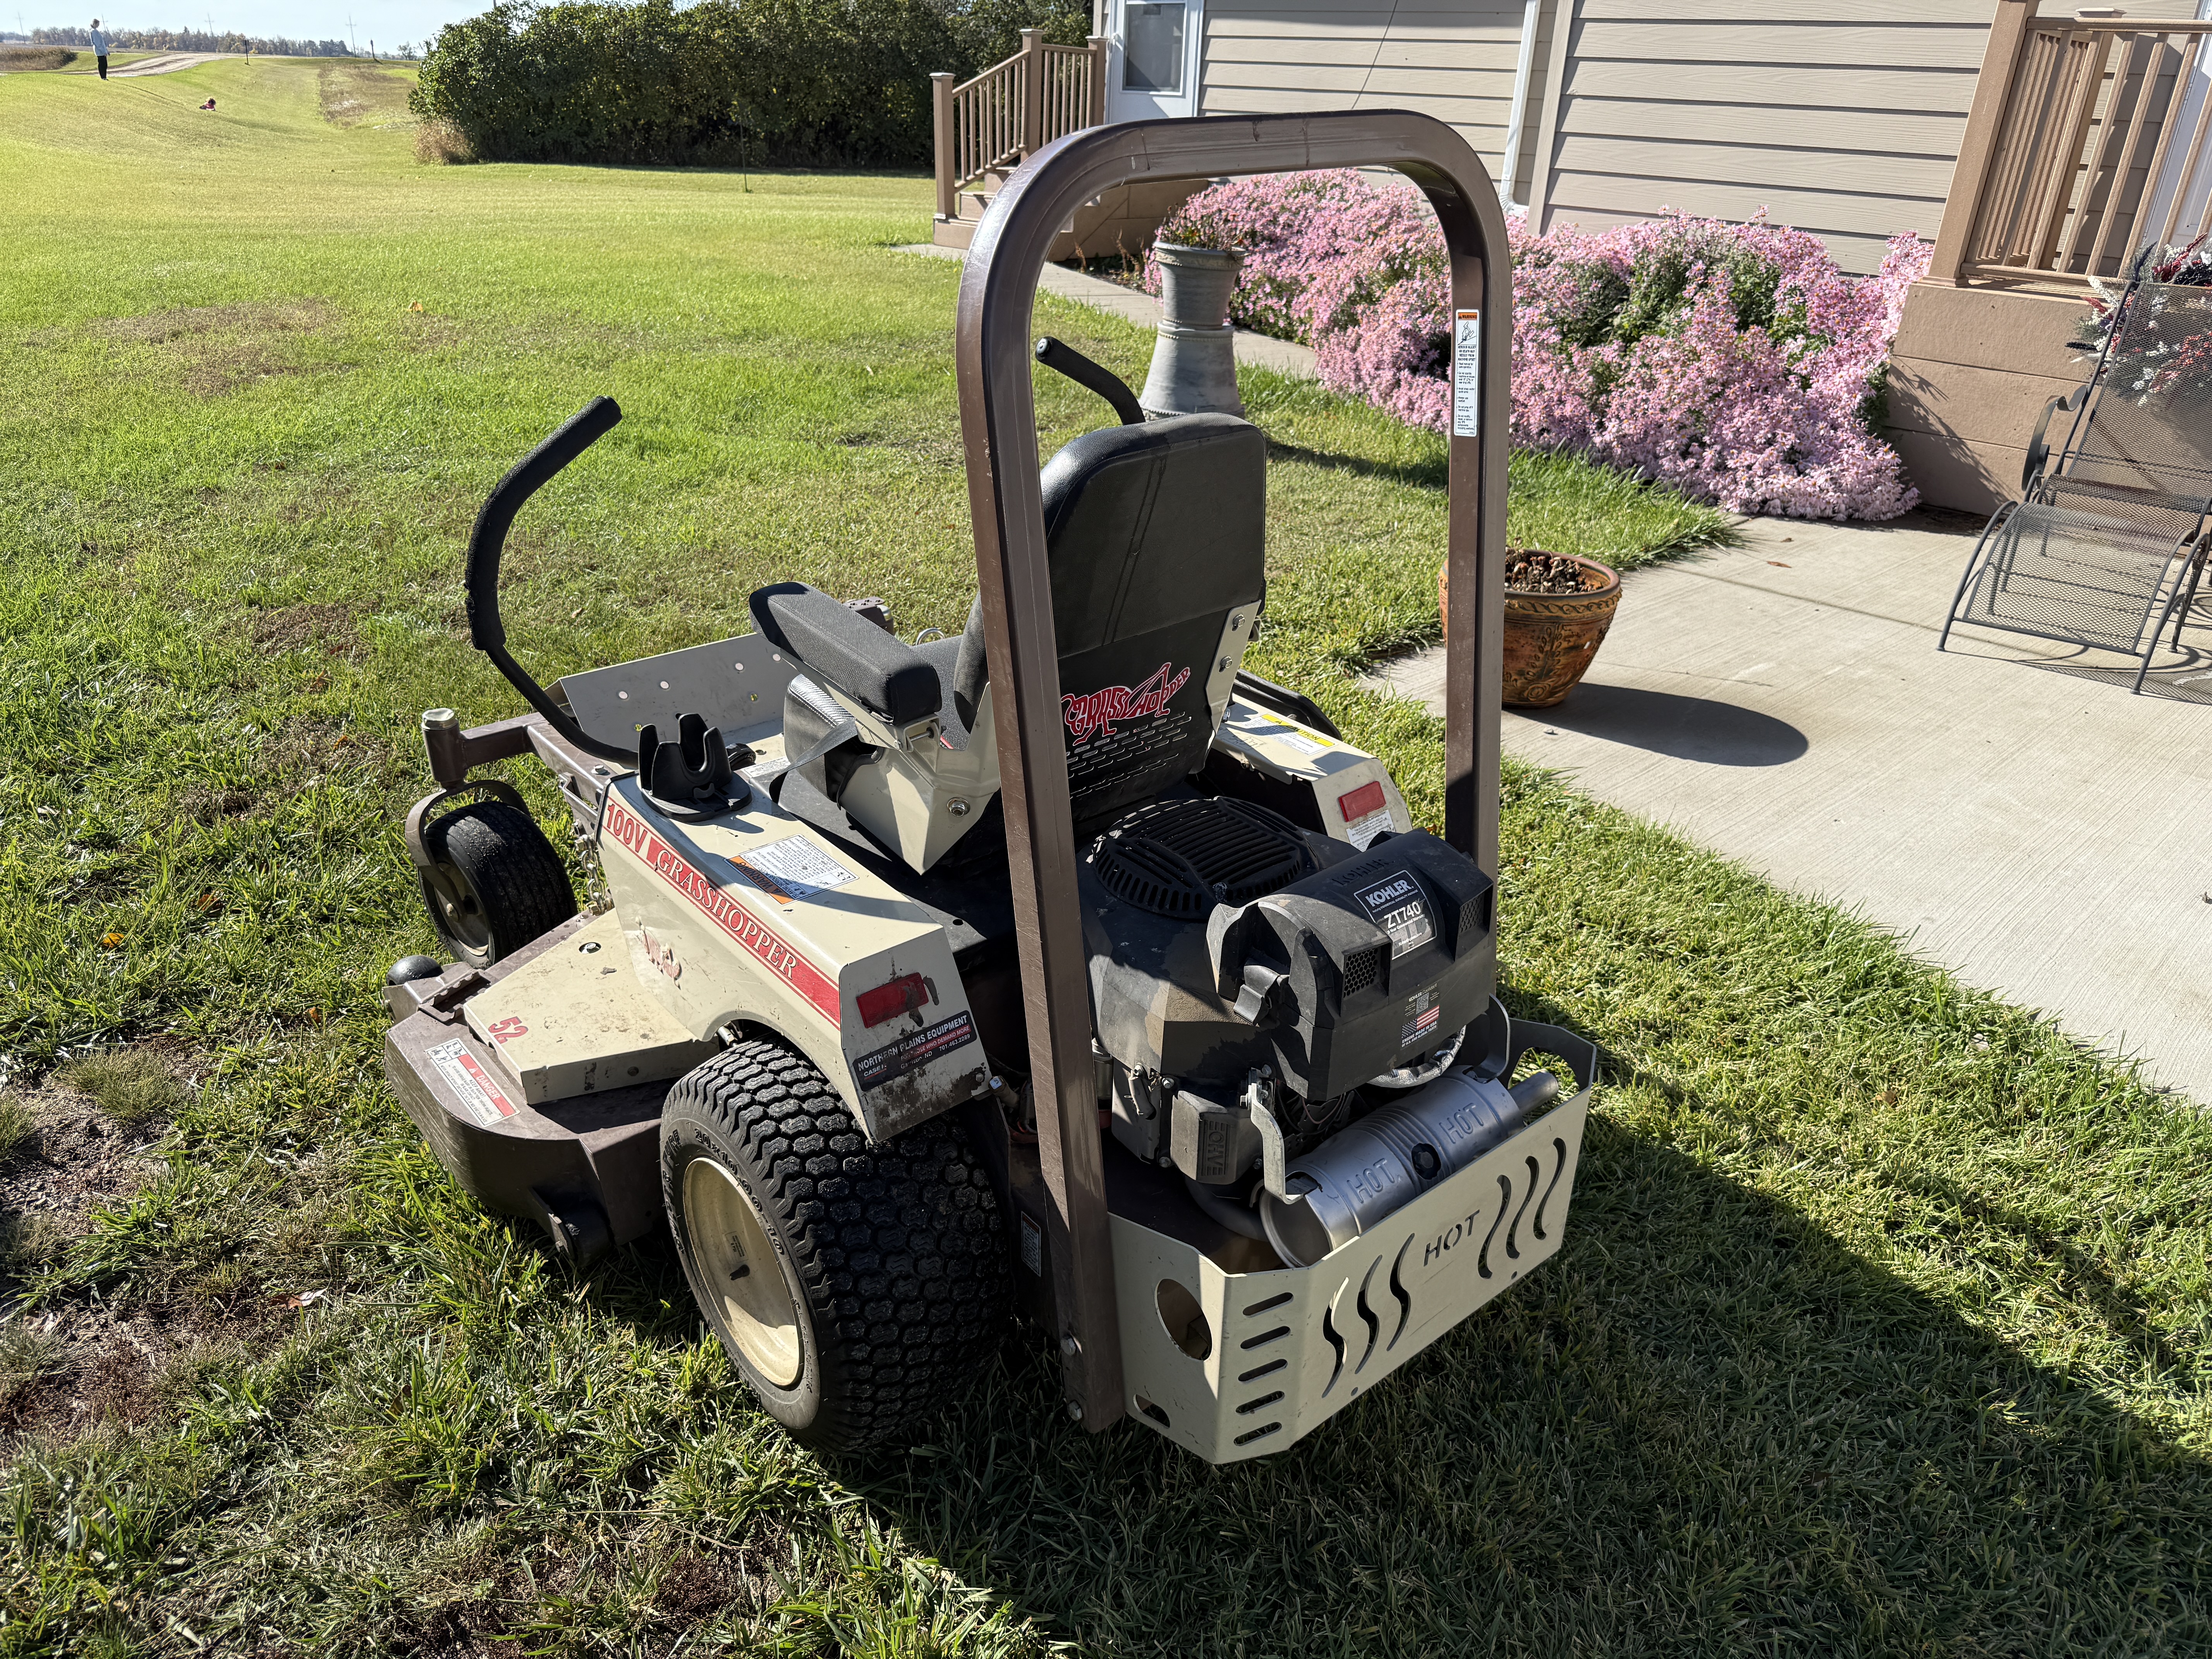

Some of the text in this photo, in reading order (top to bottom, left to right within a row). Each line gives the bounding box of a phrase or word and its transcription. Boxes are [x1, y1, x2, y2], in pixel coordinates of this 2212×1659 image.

[1061, 662, 1191, 746] GRASSHOPPER
[737, 862, 773, 889] WARNING
[607, 804, 648, 853] 100V
[657, 849, 798, 980] GRASSHOPPER
[1384, 901, 1421, 929] ZT740
[1408, 992, 1423, 1002] KOHLER
[488, 1016, 529, 1044] 52
[858, 1015, 967, 1071] NORTHERN PLAINS EQUIPMENT
[926, 1041, 937, 1049] WHO
[937, 1032, 957, 1045] DEMAND
[957, 1025, 970, 1036] MORE
[938, 1034, 971, 1052] 701.463.2289
[1402, 1034, 1415, 1043] ENGINE
[1415, 1027, 1425, 1036] MADE
[469, 1079, 478, 1087] KEEP
[864, 1066, 881, 1077] CASE
[476, 1075, 501, 1100] DANGER
[1439, 1103, 1484, 1144] HOT
[663, 1128, 683, 1162] TURF
[1207, 1131, 1224, 1167] OHV
[694, 1128, 785, 1255] 20x10.00-10
[1346, 1158, 1395, 1204] HOT
[1423, 1209, 1480, 1267] HOT
